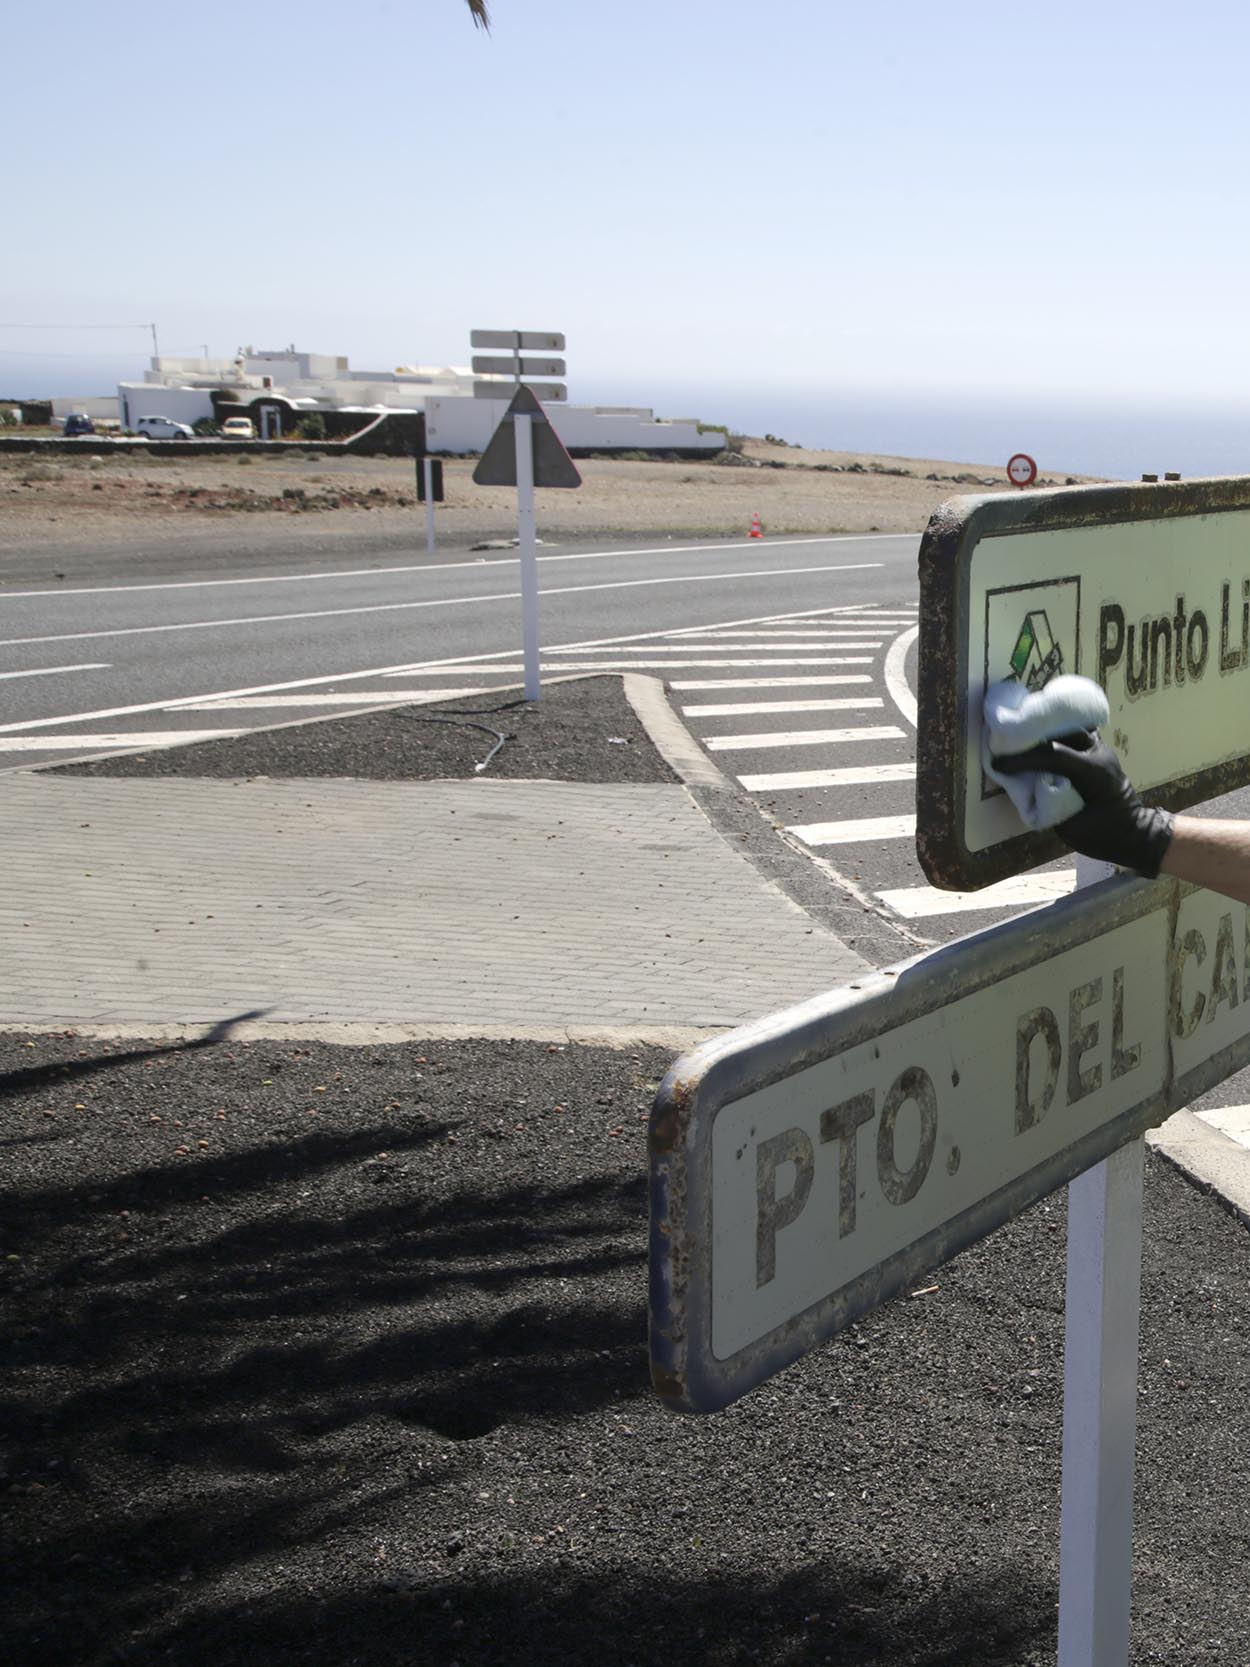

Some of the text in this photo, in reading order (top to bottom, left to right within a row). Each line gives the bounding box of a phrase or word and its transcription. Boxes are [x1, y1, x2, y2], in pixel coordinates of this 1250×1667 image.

[1099, 596, 1208, 696] Punto
[756, 1065, 961, 1289] PTO.
[1014, 966, 1141, 1137] DEL
